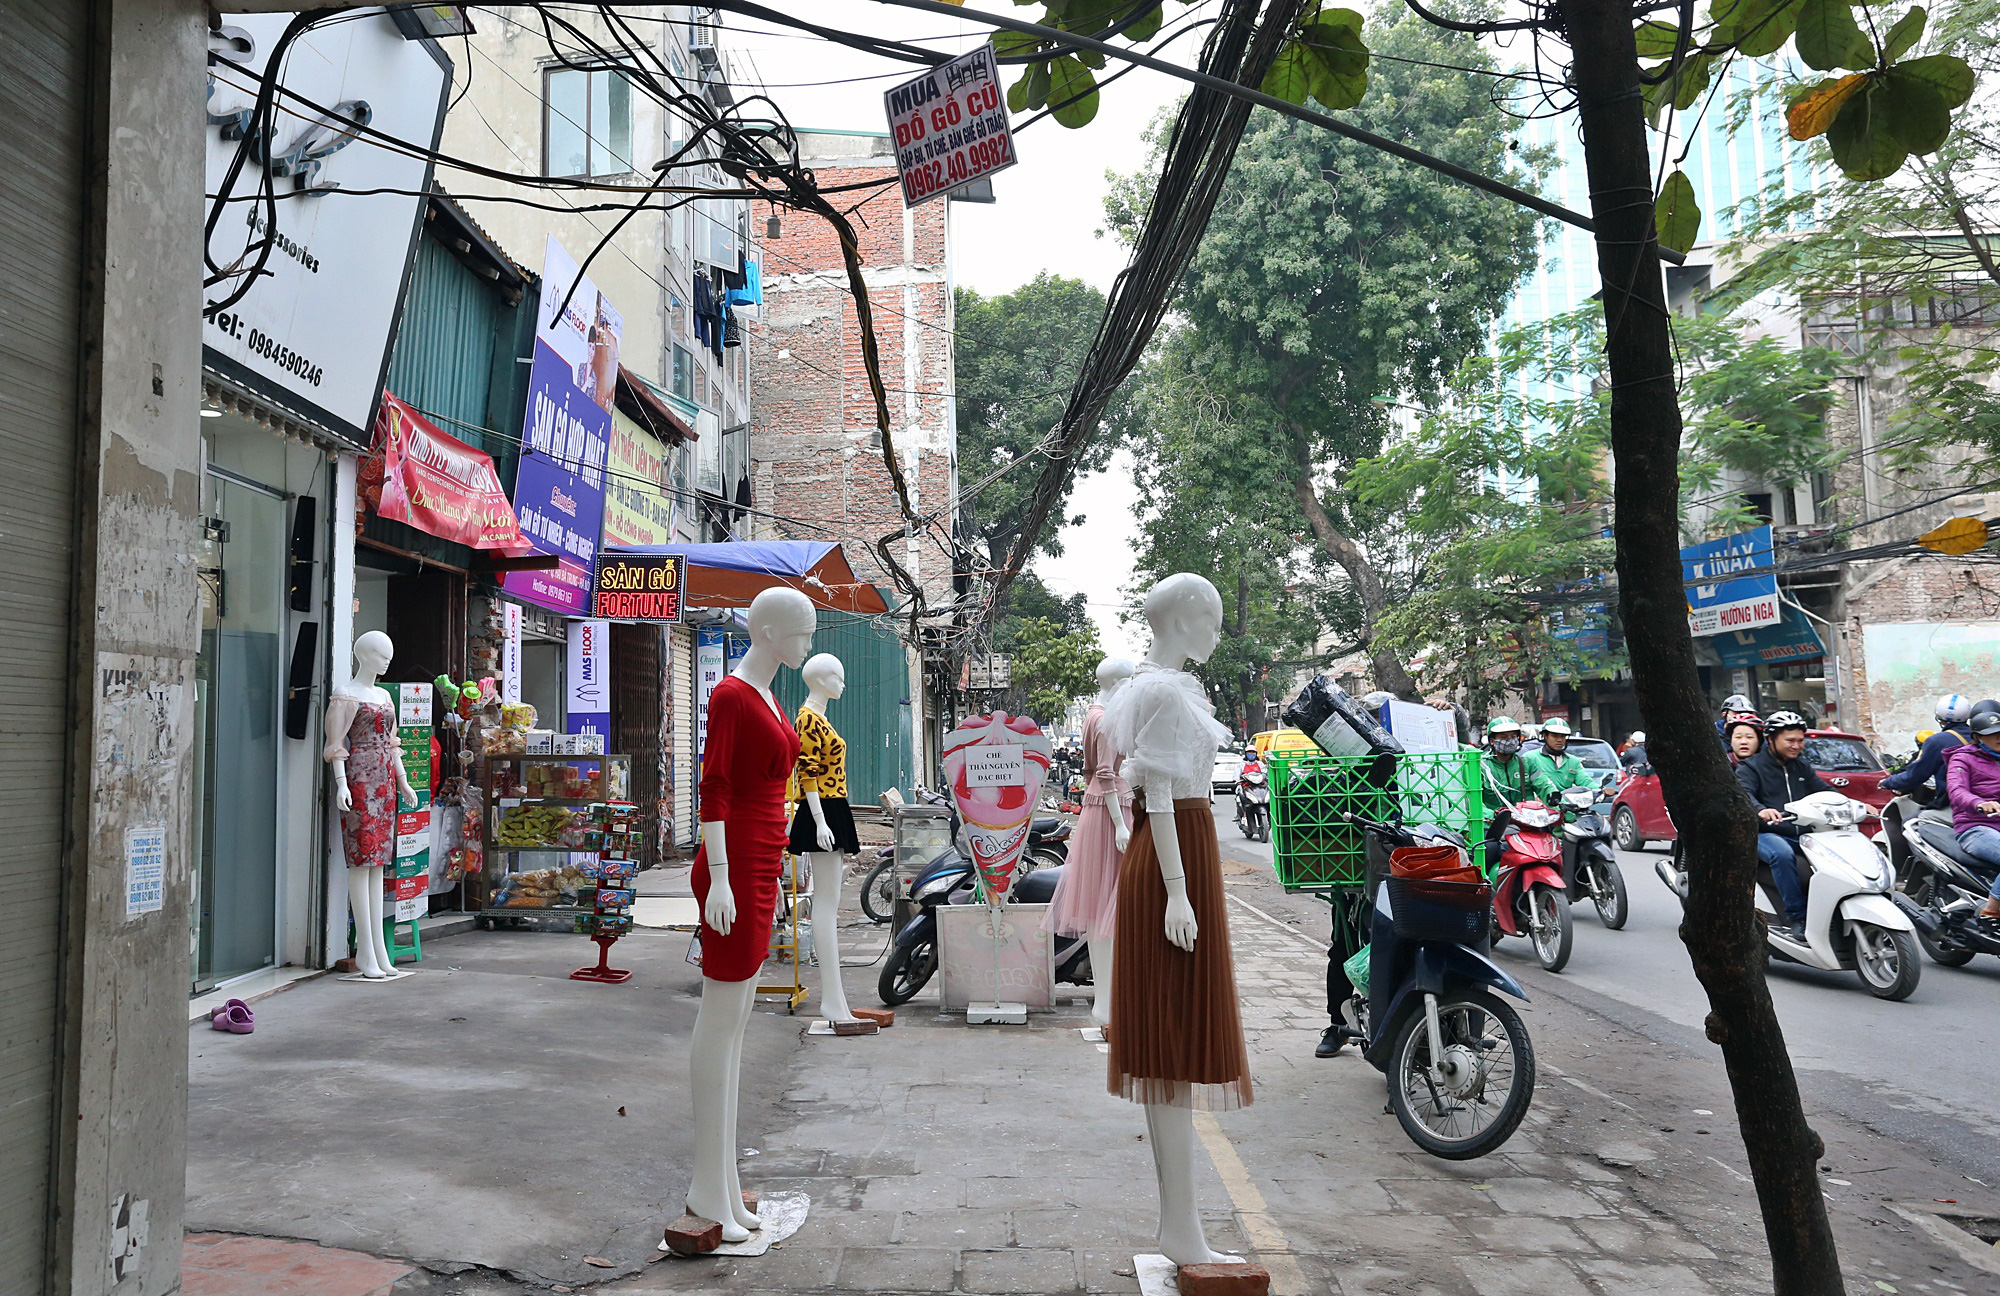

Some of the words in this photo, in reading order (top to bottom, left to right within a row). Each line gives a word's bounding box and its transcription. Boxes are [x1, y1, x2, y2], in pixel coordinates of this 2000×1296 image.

[891, 76, 941, 117] MUA
[896, 109, 925, 147] ĐỒ
[931, 94, 961, 132] GỖ
[967, 81, 998, 116] CŨ
[905, 133, 1011, 200] 0962.40.9982
[207, 299, 245, 340] Tel:
[248, 328, 323, 387] 0984590246
[531, 383, 556, 458] SÀN
[552, 391, 570, 466] GỖ
[1710, 542, 1757, 575] INAX
[601, 562, 645, 589] SÀN
[649, 559, 677, 590] GỖ
[596, 592, 678, 619] FORTUNE
[1754, 602, 1775, 623] NGA
[582, 625, 592, 656] FLOOR
[582, 657, 592, 681] MAS
[700, 654, 722, 665] Chuyên
[403, 696, 431, 704] Heineken
[402, 717, 430, 725] Heineken
[969, 762, 989, 770] THÁI
[989, 761, 1021, 770] NGUYÊN
[995, 773, 1013, 781] BIỆT
[401, 817, 417, 825] SAIGON
[133, 838, 150, 847] THÔNG
